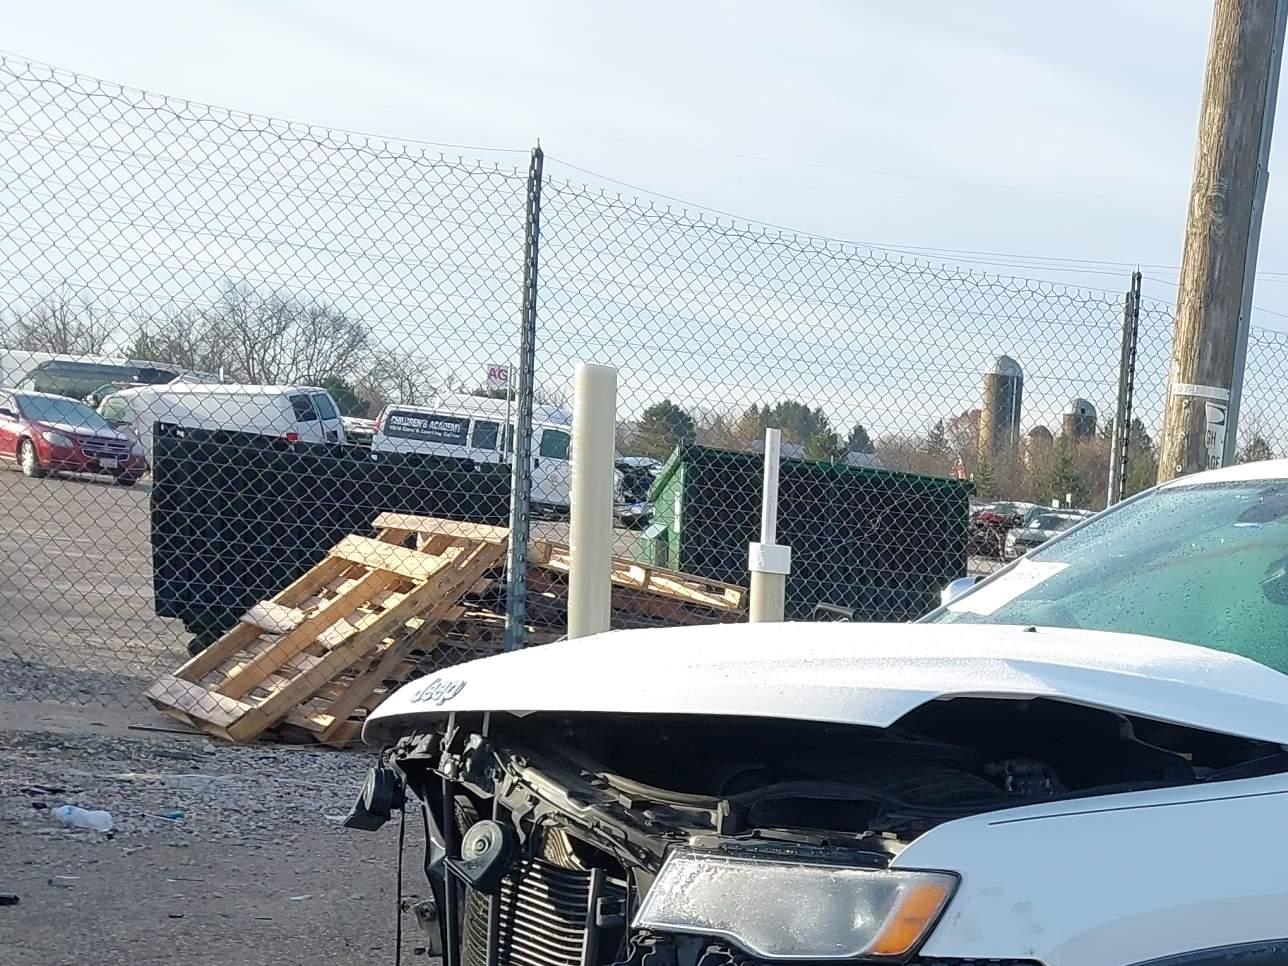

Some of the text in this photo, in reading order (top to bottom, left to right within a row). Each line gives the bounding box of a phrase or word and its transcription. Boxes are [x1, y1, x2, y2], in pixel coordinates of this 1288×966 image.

[390, 415, 461, 433] CHILDREN'S ACADEMY
[410, 678, 467, 706] Jeep
